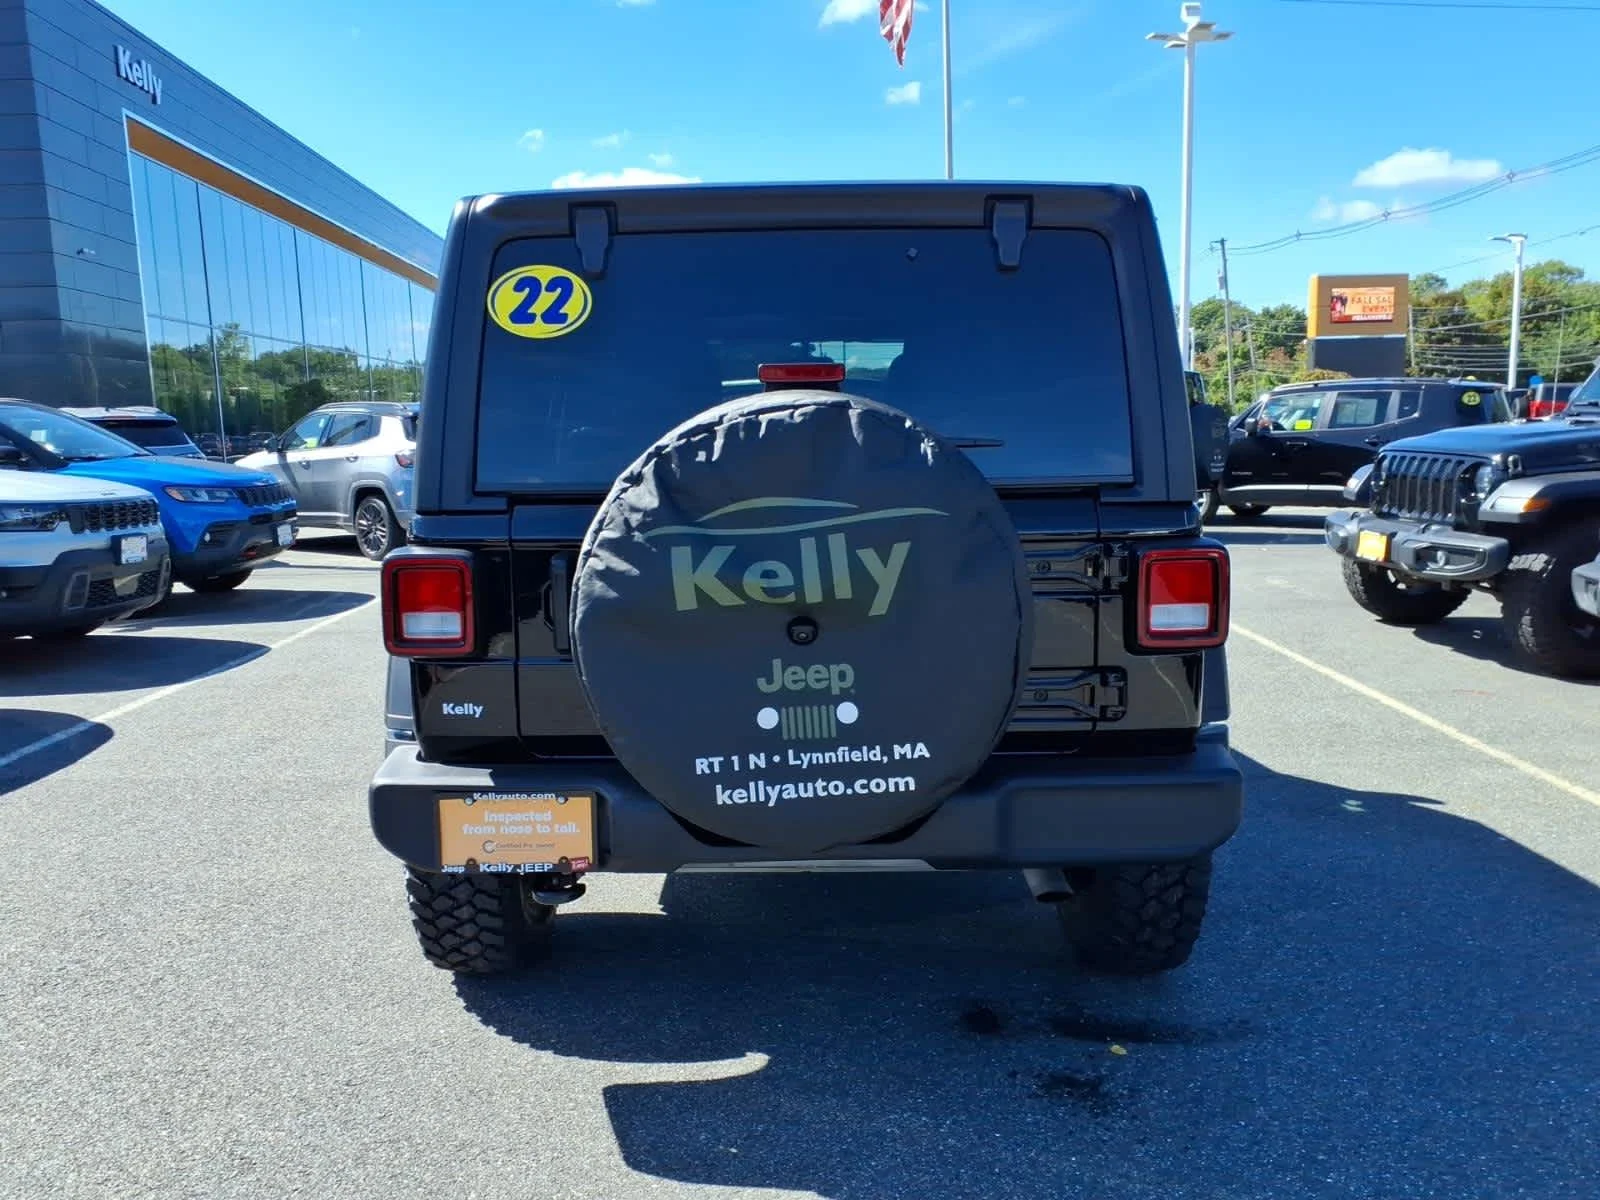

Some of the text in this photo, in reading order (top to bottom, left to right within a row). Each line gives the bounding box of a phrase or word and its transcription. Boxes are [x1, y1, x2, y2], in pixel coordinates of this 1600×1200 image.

[116, 45, 162, 105] Kelly
[508, 275, 574, 325] 22
[670, 532, 911, 617] Kelly
[757, 658, 855, 695] Jeep
[442, 703, 484, 718] Kelly
[695, 742, 931, 775] RT 1 N Lynnfield, MA
[473, 792, 556, 801] Kellyauto.com
[715, 776, 916, 807] kellyauto.com
[462, 822, 581, 835] from nose to tail.
[484, 810, 552, 824] Inspected
[441, 864, 466, 874] Jeep
[479, 863, 553, 873] Kelly JEEP
